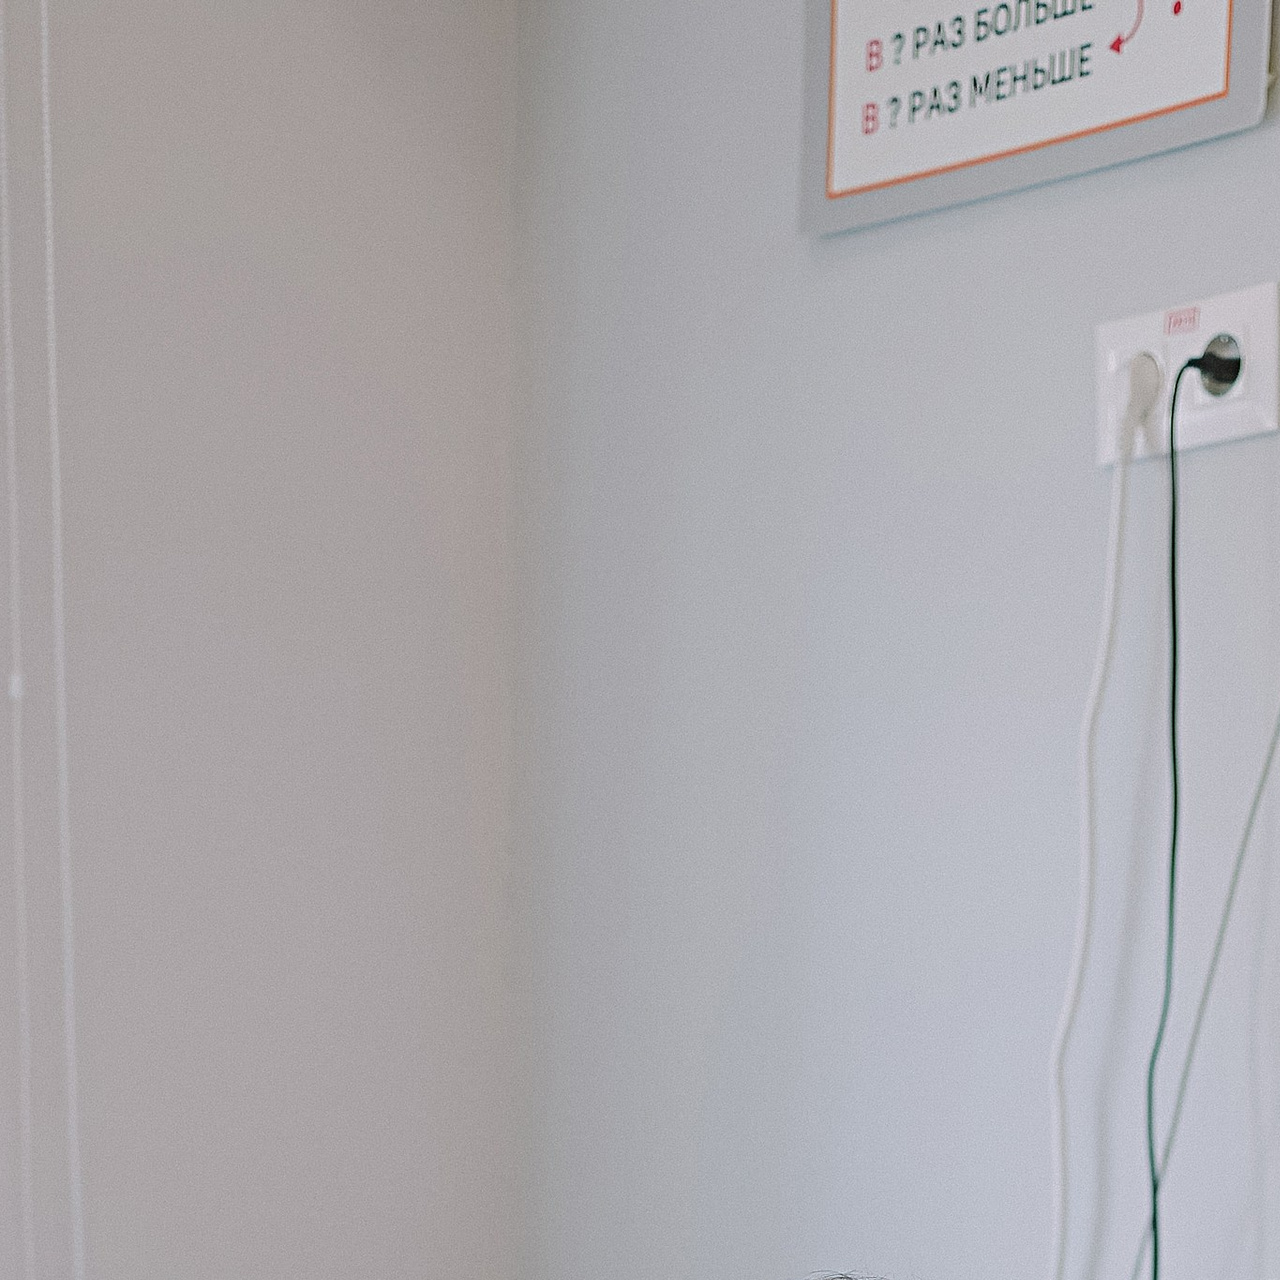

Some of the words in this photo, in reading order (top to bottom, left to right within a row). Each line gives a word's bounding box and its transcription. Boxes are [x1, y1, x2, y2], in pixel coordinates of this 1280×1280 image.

[864, 39, 883, 73] В
[912, 15, 966, 60] РАЗ
[860, 100, 881, 137] В
[906, 78, 964, 124] РАЗ
[968, 42, 1092, 109] МЕНЬШЕ
